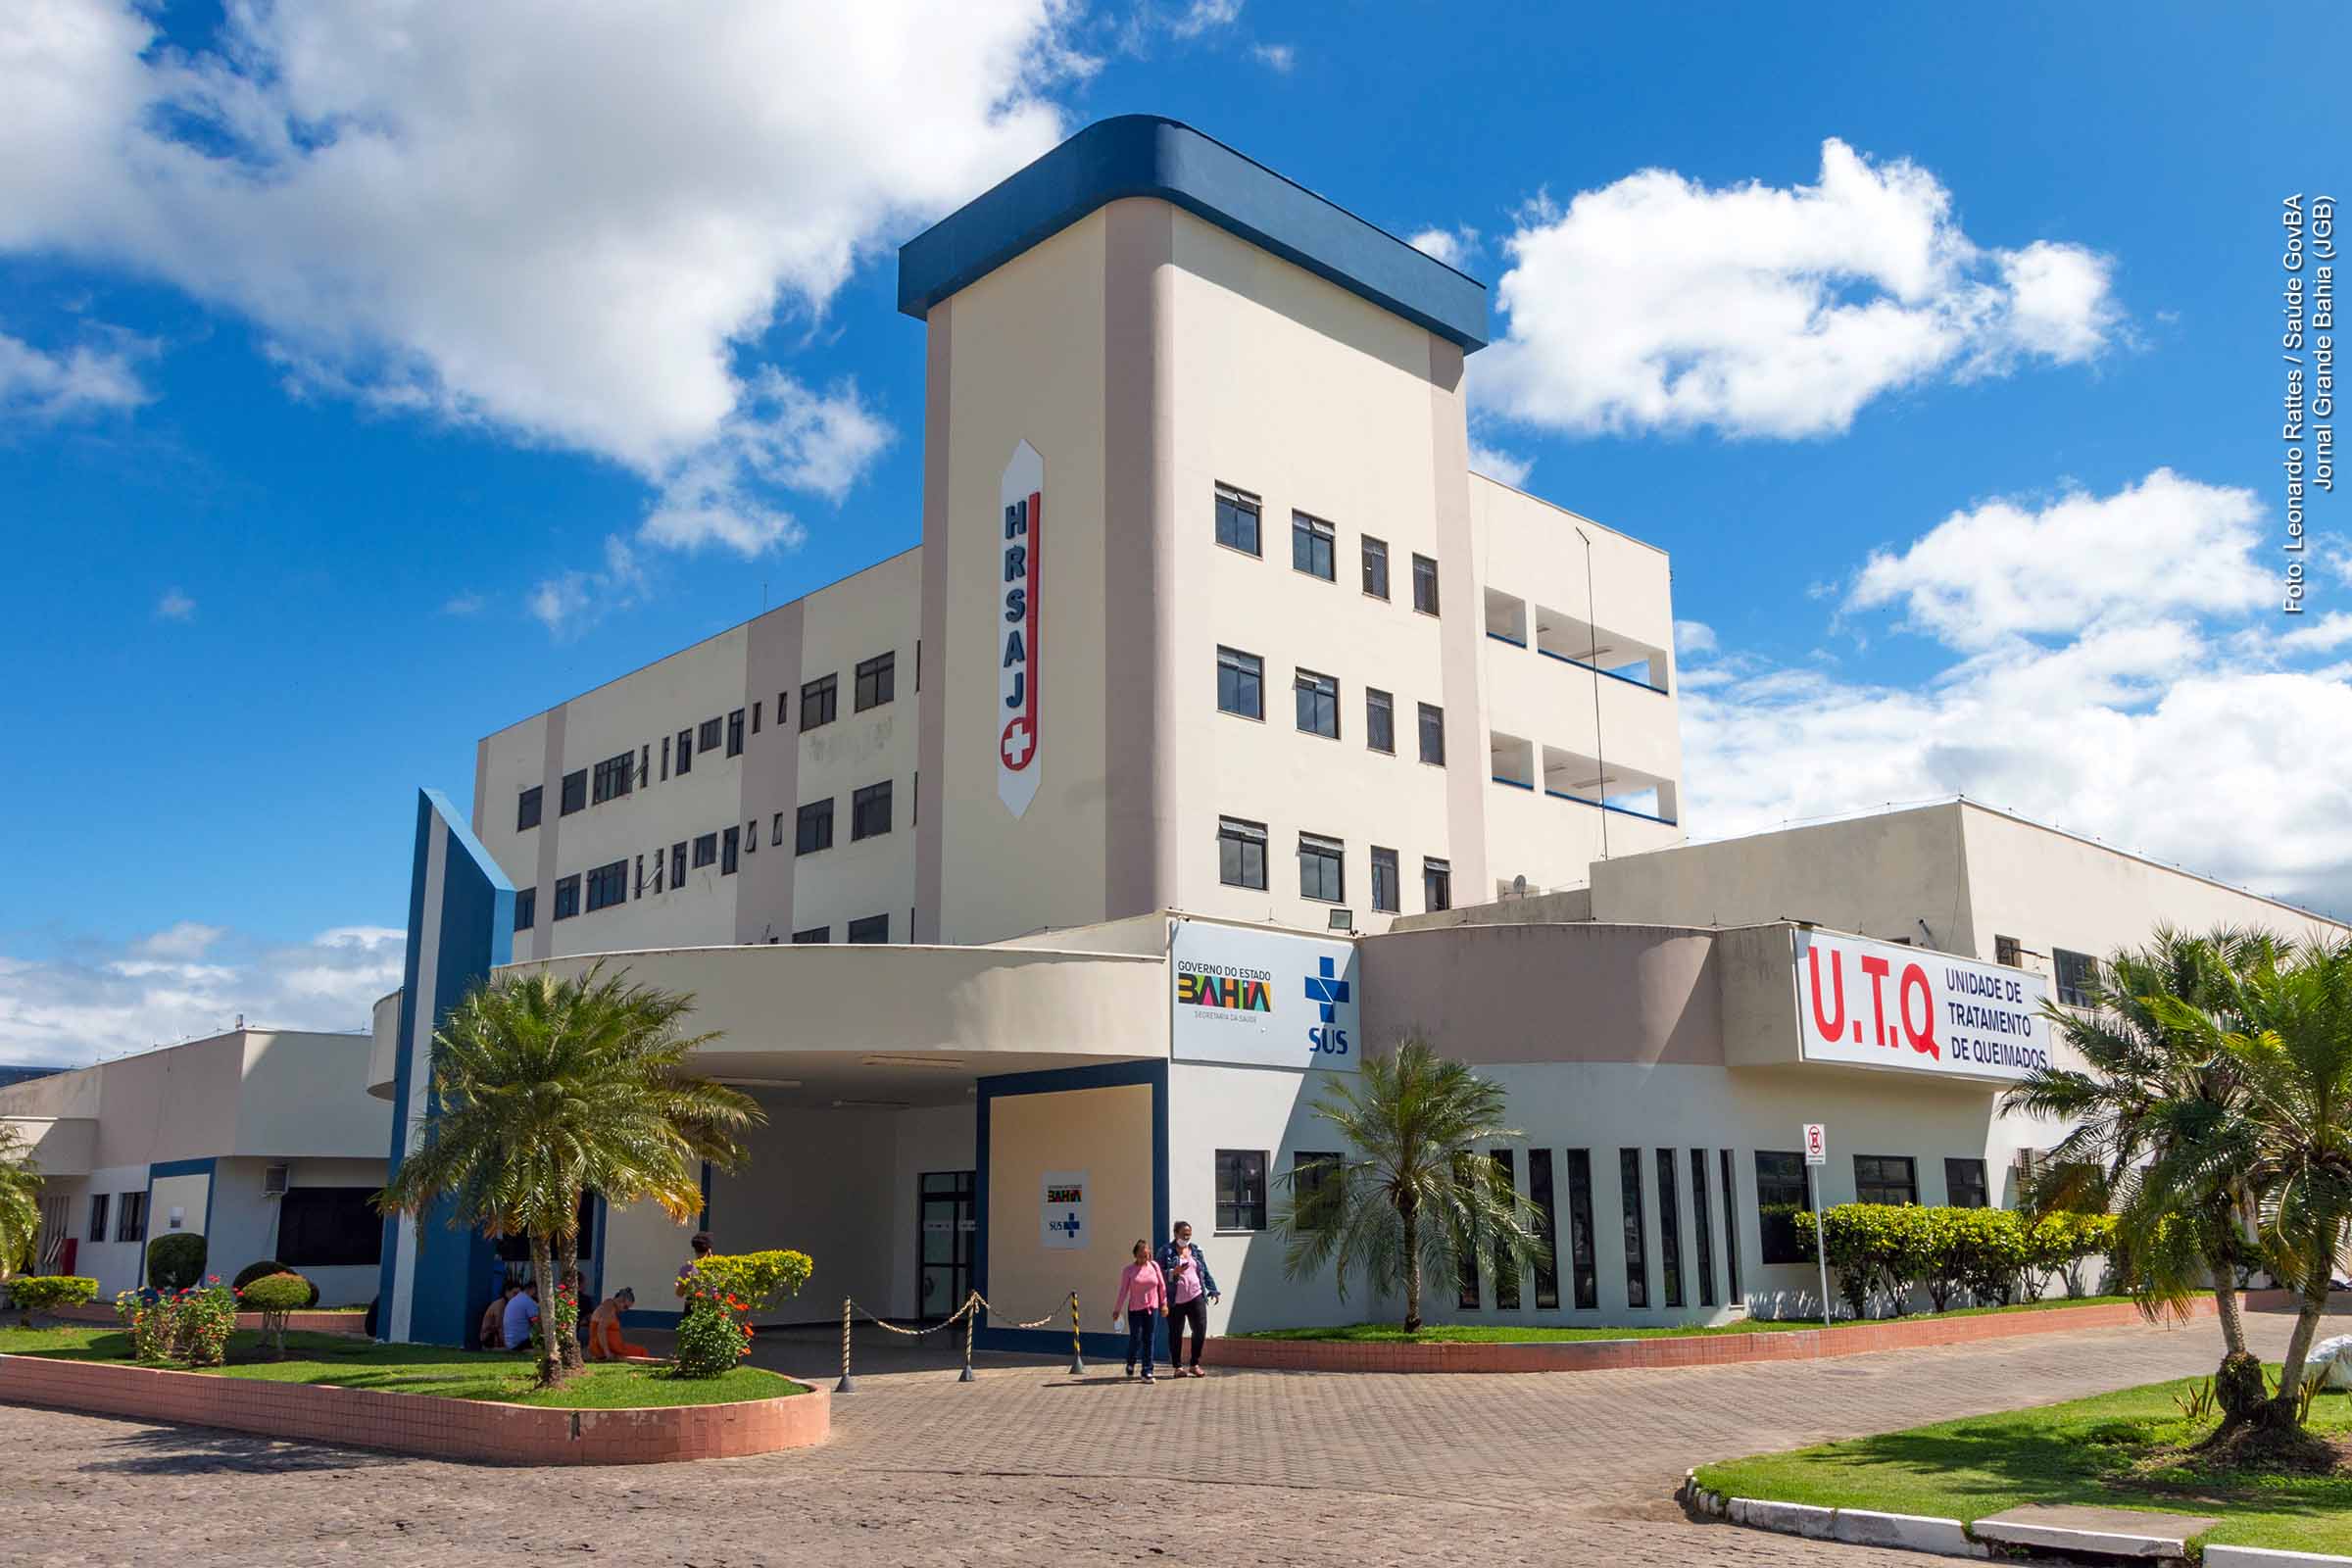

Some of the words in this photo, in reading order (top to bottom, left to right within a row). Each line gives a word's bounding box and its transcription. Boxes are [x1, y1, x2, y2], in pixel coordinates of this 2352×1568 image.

[1004, 500, 1027, 709] HRSAJ
[1178, 960, 1222, 976] GOVERNO
[1225, 965, 1238, 977] DO
[1239, 967, 1271, 981] ESTADO
[1945, 966, 2003, 1001] UNIDADE
[2006, 979, 2023, 1004] DE
[1178, 972, 1271, 1012] BAHIA
[1807, 946, 1940, 1061] U.T.Q
[1947, 1002, 2032, 1037] TRATAMENTO
[1308, 1027, 1348, 1054] SUS
[1951, 1037, 1970, 1060] DE
[1973, 1041, 2047, 1071] QUEIMADOS
